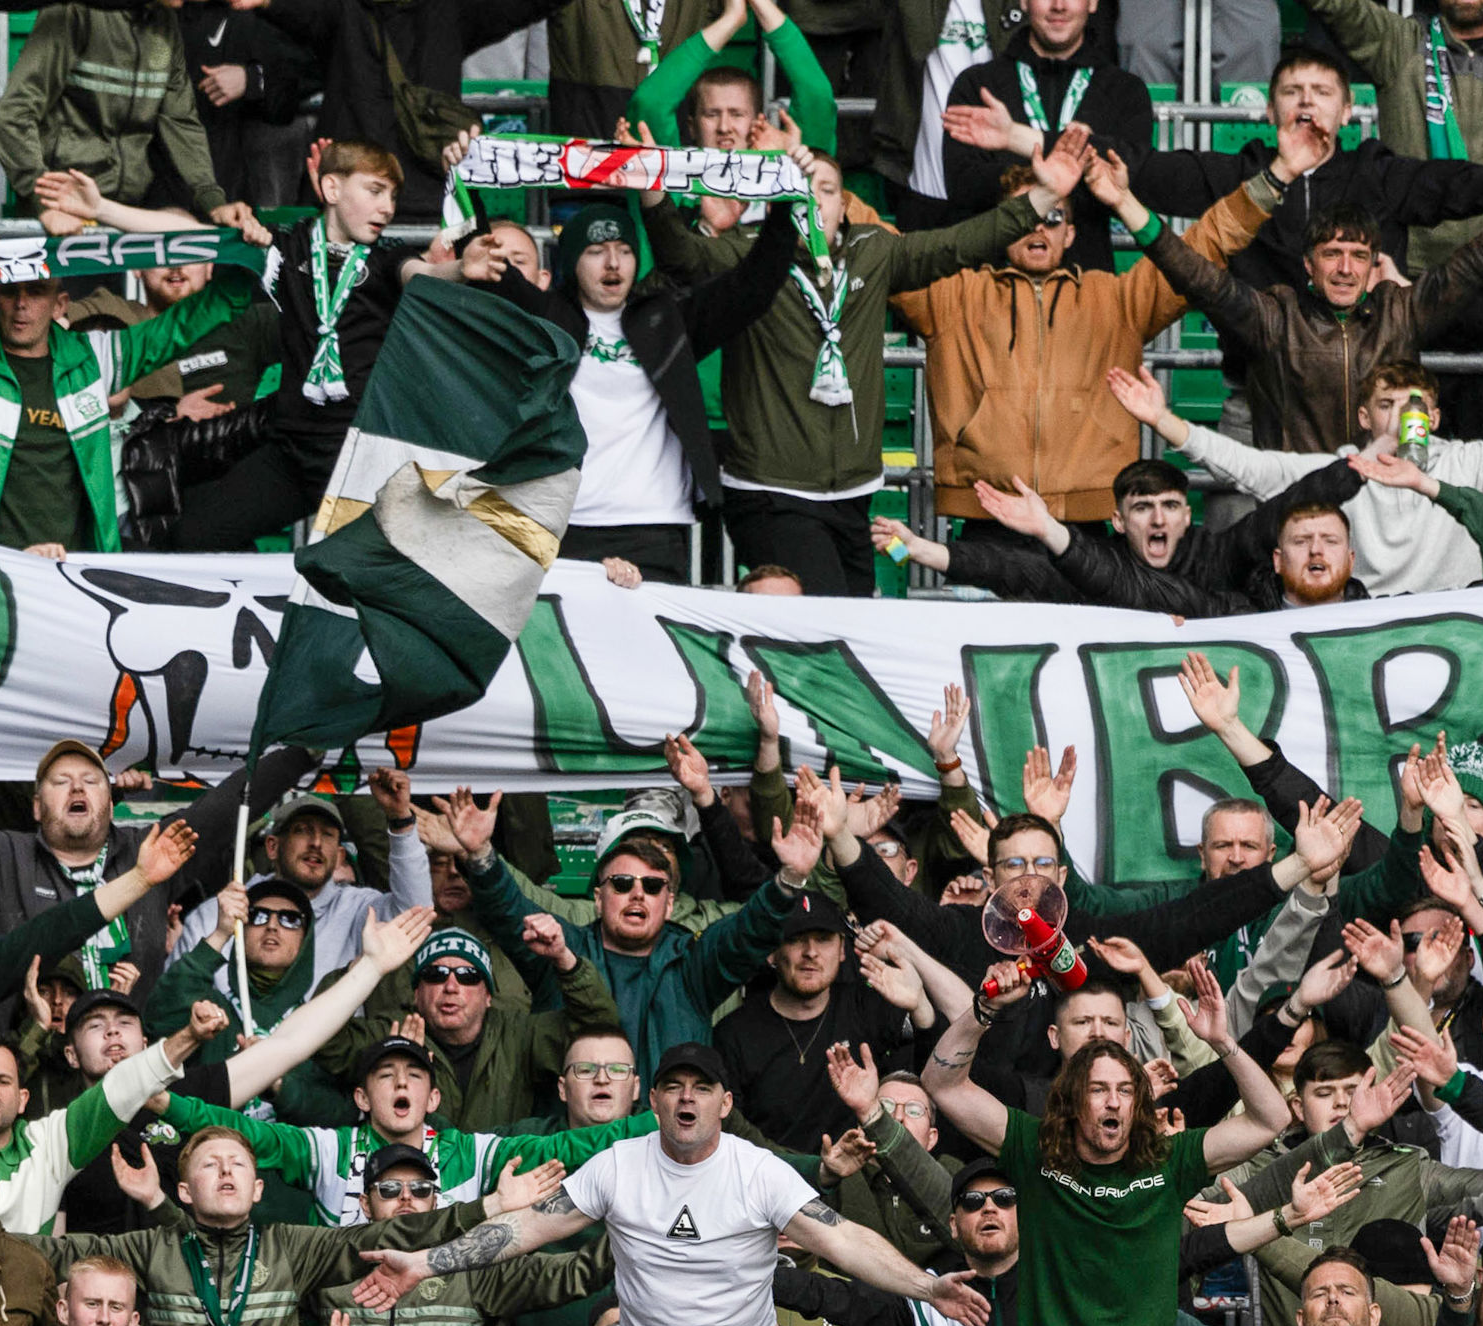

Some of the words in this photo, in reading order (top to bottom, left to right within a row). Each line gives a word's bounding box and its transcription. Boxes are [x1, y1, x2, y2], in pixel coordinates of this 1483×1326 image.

[26, 407, 66, 428] YEA
[1040, 1166, 1092, 1195] GREEN
[1093, 1172, 1167, 1199] BRIGADE
